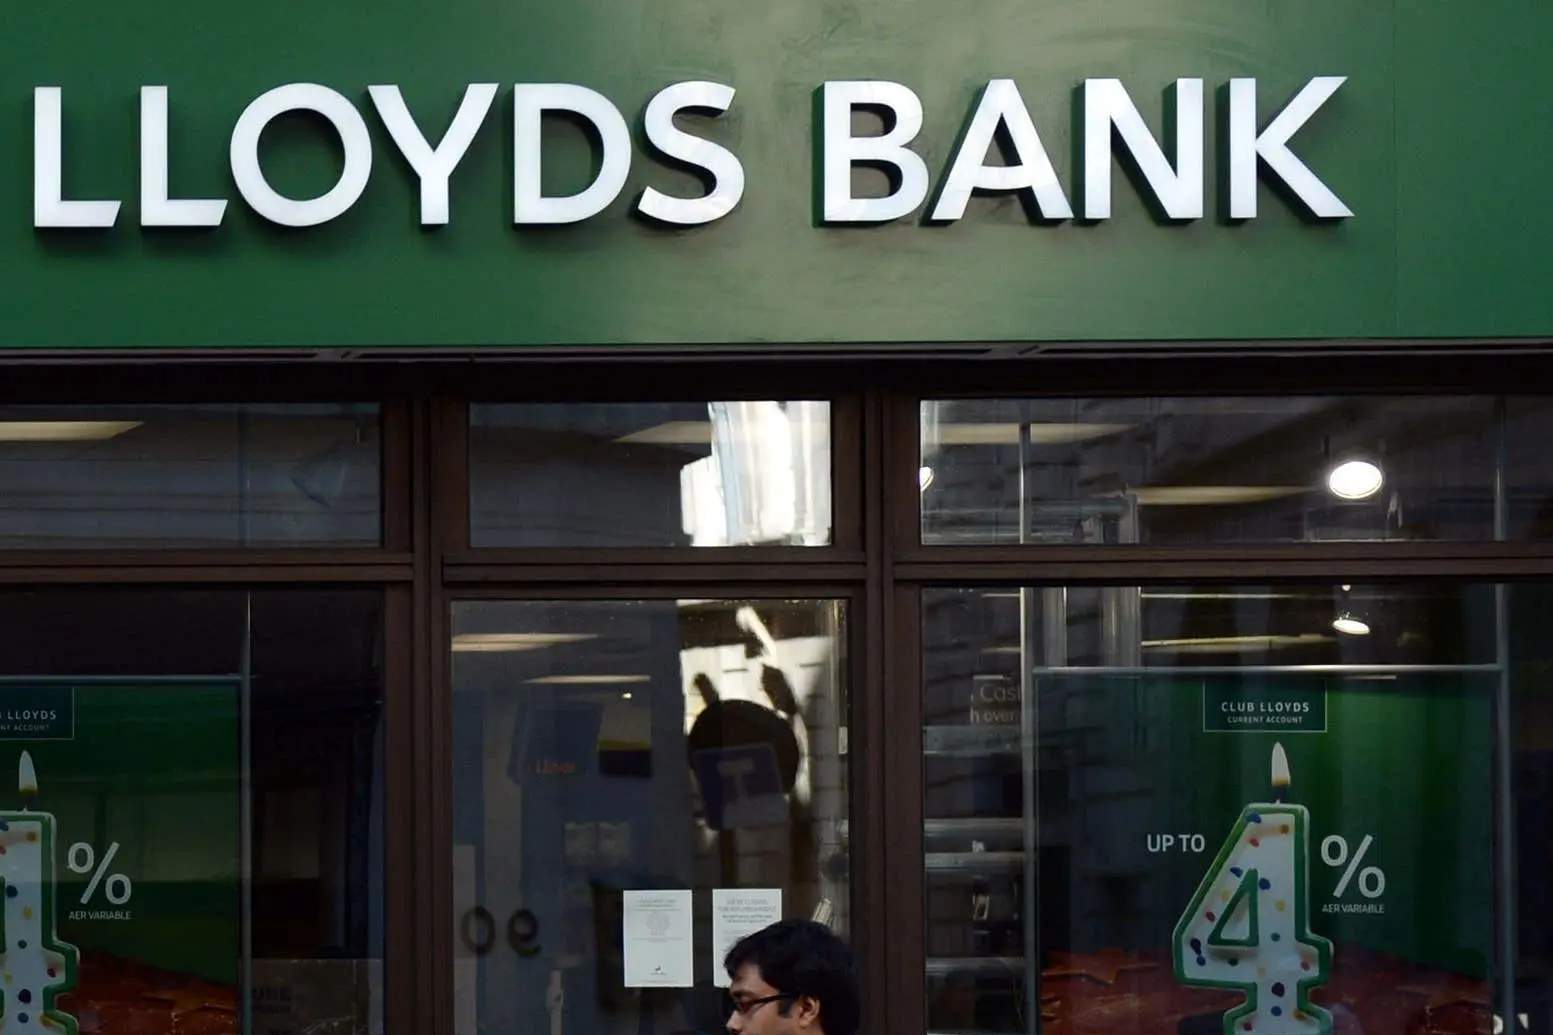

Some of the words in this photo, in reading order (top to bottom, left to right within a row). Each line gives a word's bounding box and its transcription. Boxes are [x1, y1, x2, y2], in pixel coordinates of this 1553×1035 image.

[34, 80, 745, 227] LLOYDS
[822, 76, 1354, 223] BANK
[1221, 702, 1254, 712] CLUB
[1260, 702, 1309, 712] LLOYDS
[7, 709, 56, 720] LLOYDS
[1227, 715, 1263, 724] CURRENT
[1266, 715, 1303, 724] ACCOUNT
[13, 723, 50, 732] ACCOUNT
[1147, 834, 1174, 852] UP
[1178, 834, 1205, 853] TO
[1320, 834, 1386, 898] %
[67, 841, 132, 905] %
[1321, 903, 1340, 914] AER
[1341, 903, 1385, 914] VARIABLE
[68, 910, 87, 921] AER
[88, 910, 132, 921] VARIABLE
